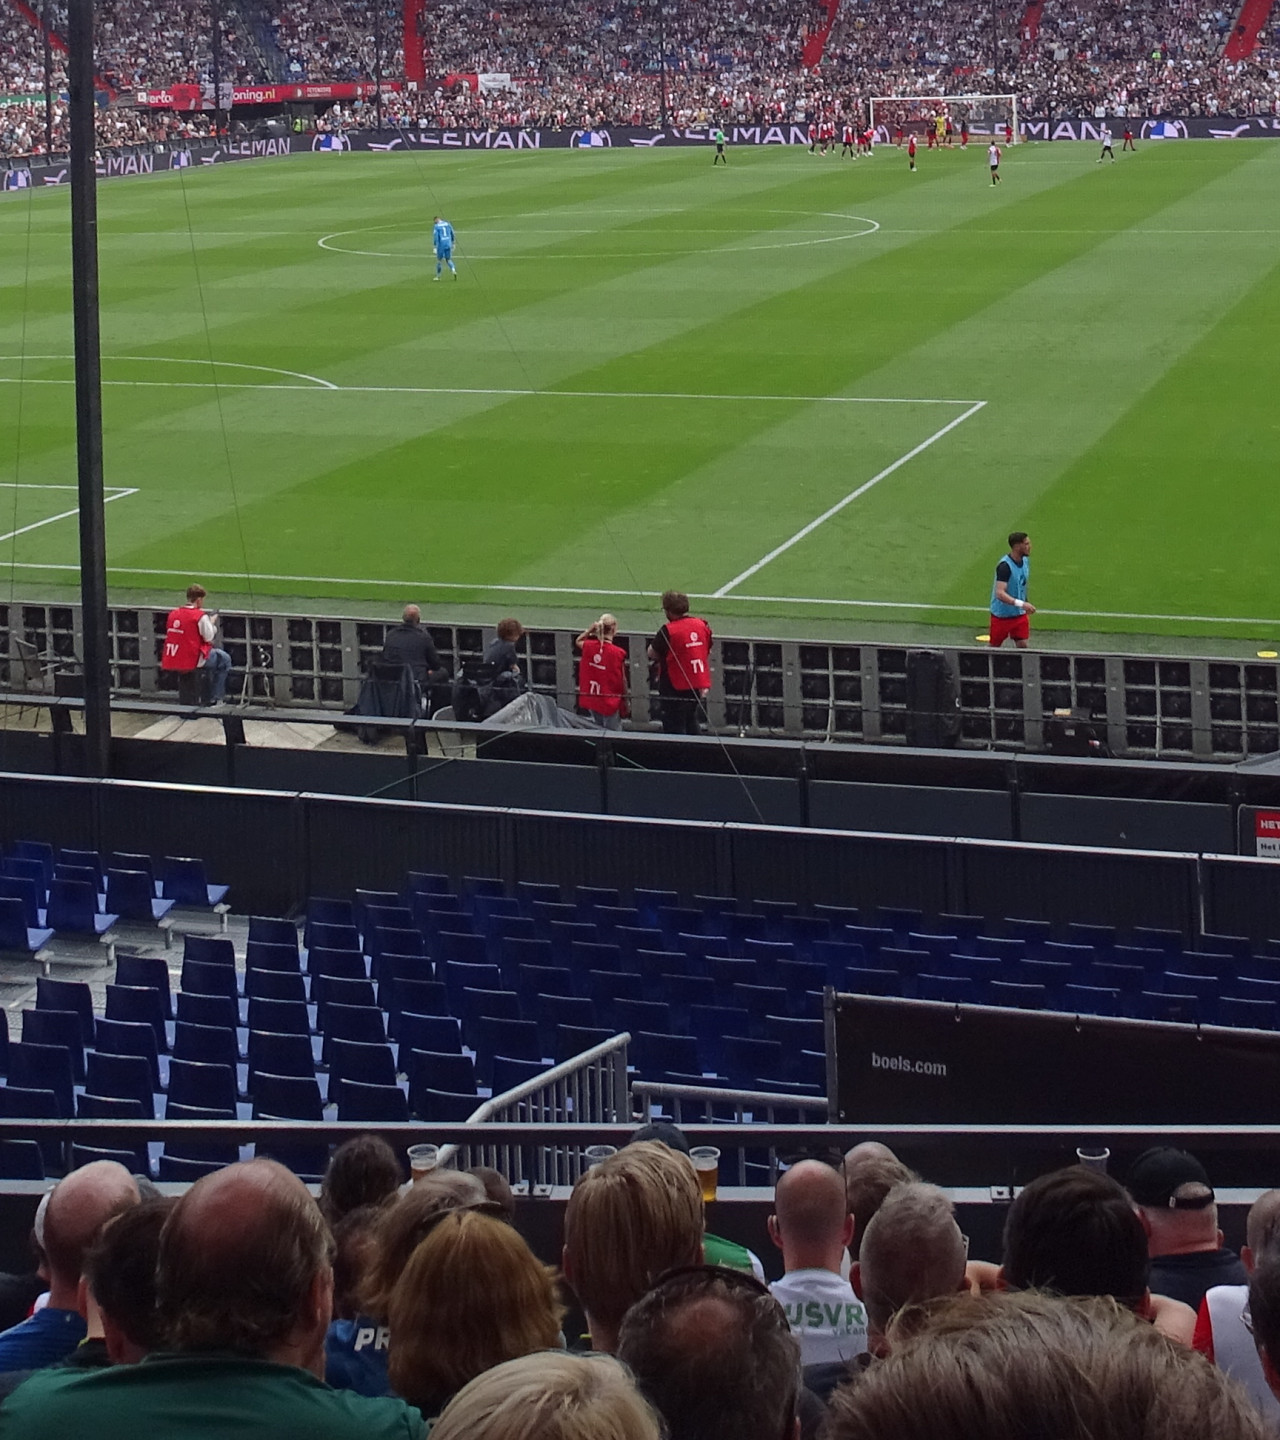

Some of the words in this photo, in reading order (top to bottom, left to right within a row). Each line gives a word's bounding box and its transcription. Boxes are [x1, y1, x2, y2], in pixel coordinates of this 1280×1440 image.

[166, 643, 179, 657] TV
[690, 659, 704, 674] TV
[589, 680, 601, 695] TV
[1261, 843, 1276, 851] Het
[872, 1052, 947, 1076] boels.com
